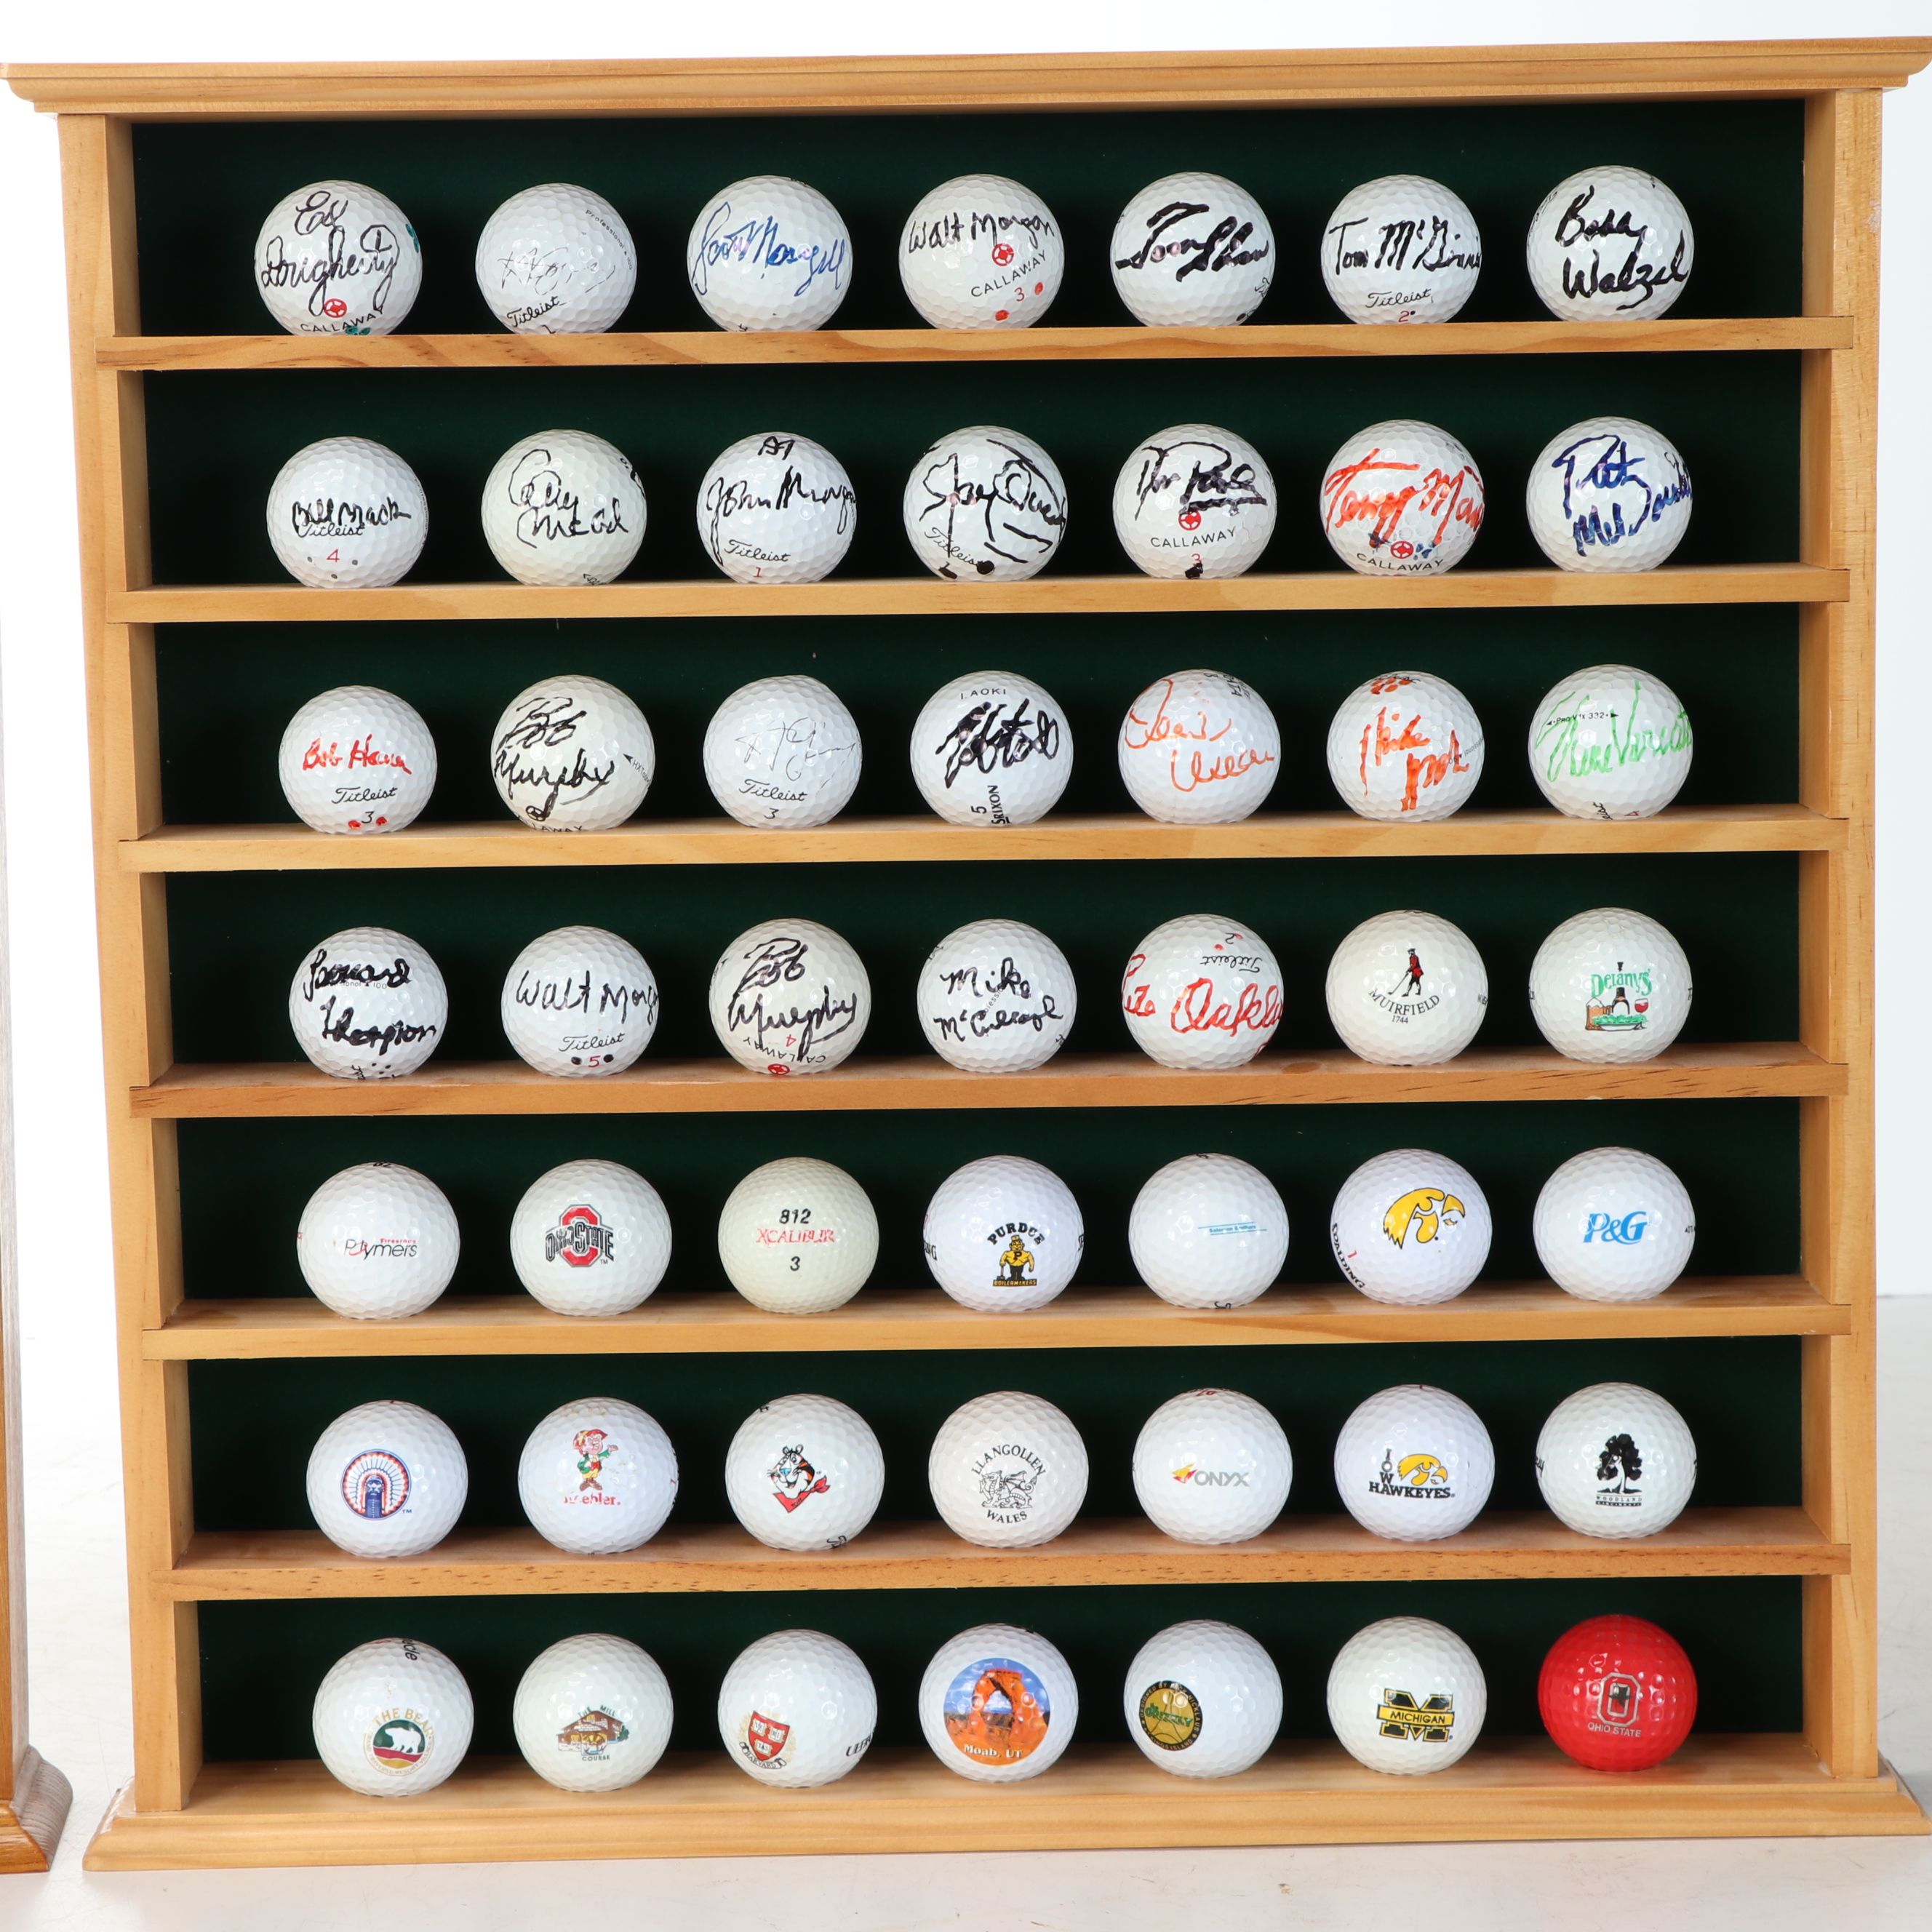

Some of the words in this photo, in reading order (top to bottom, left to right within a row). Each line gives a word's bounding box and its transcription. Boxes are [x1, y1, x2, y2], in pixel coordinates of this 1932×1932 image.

[585, 209, 626, 250] Professional
[909, 212, 963, 254] Walt
[1329, 217, 1369, 276] Tom
[970, 251, 1048, 298] CALLAWAY
[1015, 287, 1026, 301] 3
[1365, 288, 1432, 308] Titleist
[507, 295, 567, 329] Titleist
[1397, 311, 1410, 323] 2
[296, 522, 366, 538] Titleist
[1150, 527, 1237, 548] CALLAWAY
[326, 548, 340, 563] 4
[724, 539, 791, 562] Titleist
[1356, 552, 1444, 572] CALLAWAY
[753, 566, 763, 578] 1
[970, 687, 1007, 698] AOKI
[331, 787, 398, 805] Titleist
[739, 778, 809, 802] Titleist
[764, 807, 777, 819] 3
[970, 806, 986, 814] 5
[987, 785, 1010, 825] SRIXON
[362, 811, 373, 823] 3
[1199, 954, 1263, 975] Titleist
[516, 970, 591, 1013] Walt
[1368, 989, 1440, 1015] MUIRFIELD
[1391, 1015, 1409, 1023] 1744
[558, 1032, 625, 1052] Titleist
[786, 1034, 797, 1047] 4
[588, 1055, 601, 1069] 5
[779, 1208, 811, 1225] 812
[756, 1228, 836, 1244] XCALIBUR
[986, 1222, 1045, 1245] PURDUE
[1583, 1210, 1648, 1245] P&G
[344, 1237, 418, 1261] Polymers
[575, 1218, 615, 1263] STATE
[789, 1256, 801, 1272] 3
[993, 1279, 1037, 1287] BOILERMAKERS
[970, 1443, 1047, 1476] LLANGOLLEN
[1193, 1471, 1250, 1488] ONYX
[1368, 1482, 1451, 1499] HAWKEYES
[986, 1510, 1028, 1524] WALES
[373, 1709, 401, 1726] THE
[599, 1705, 616, 1717] MILL
[1389, 1712, 1445, 1725] MICHIGAN
[1587, 1722, 1611, 1733] OHIO
[1613, 1727, 1642, 1737] STATE
[743, 1752, 776, 1768] HARVARD
[964, 1744, 1001, 1758] Moab,
[1005, 1748, 1023, 1759] UT
